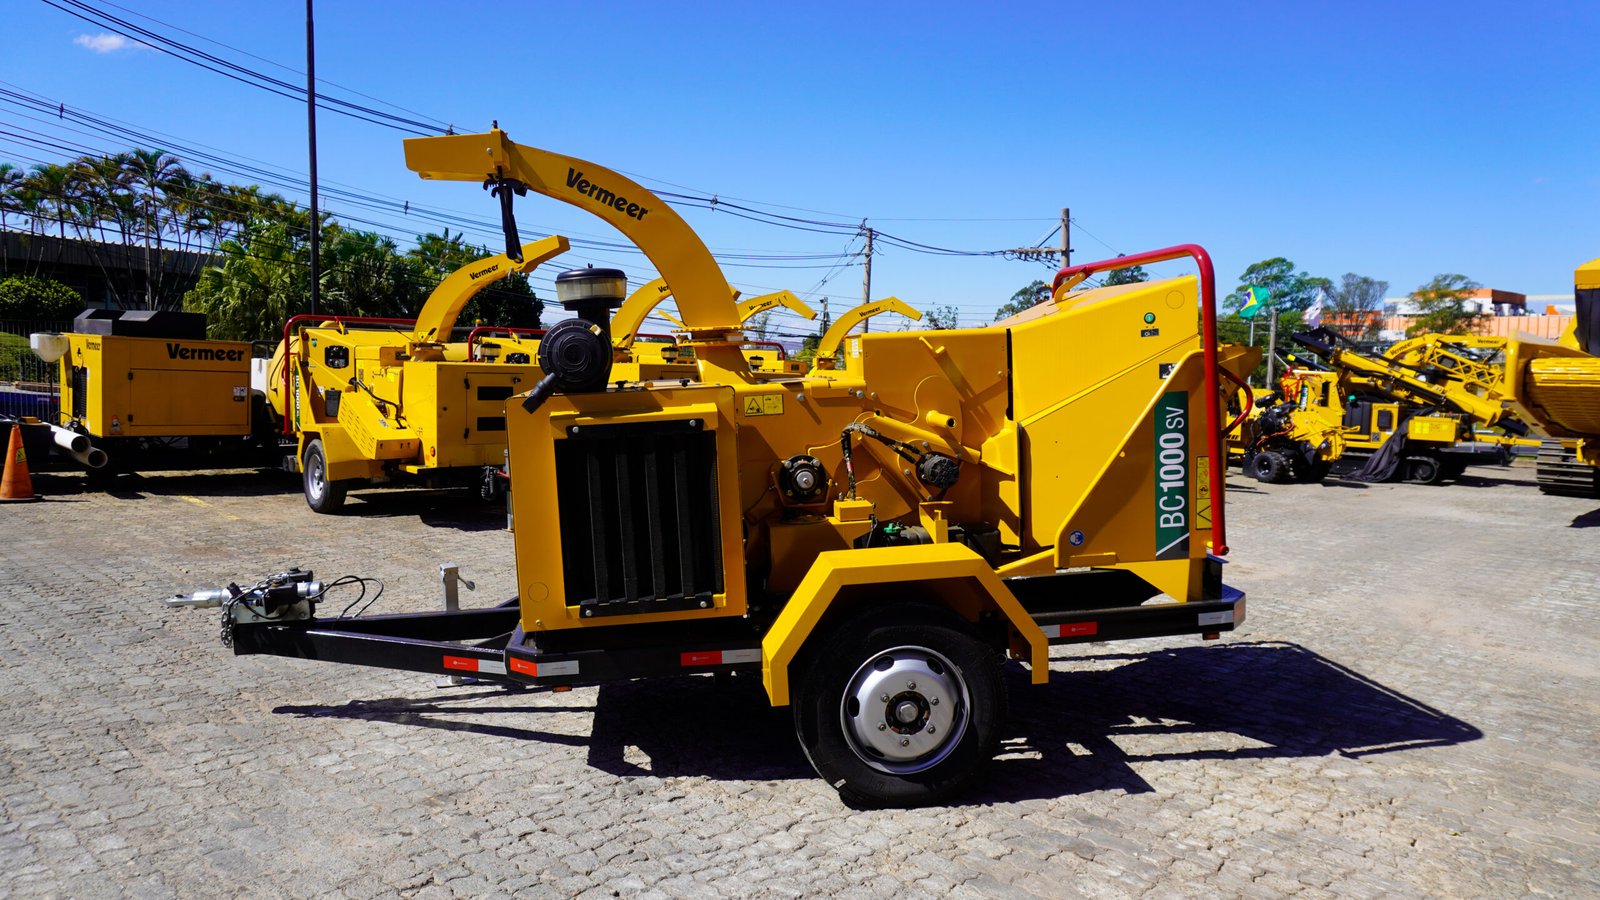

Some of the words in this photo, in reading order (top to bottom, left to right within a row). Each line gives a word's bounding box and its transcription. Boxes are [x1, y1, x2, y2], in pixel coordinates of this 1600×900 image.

[566, 167, 648, 220] Vermeer
[469, 264, 499, 280] Vermeer
[858, 306, 881, 317] Vermeer
[166, 343, 244, 361] Vermeer
[1389, 341, 1413, 355] Vermeer
[1165, 406, 1185, 429] SV
